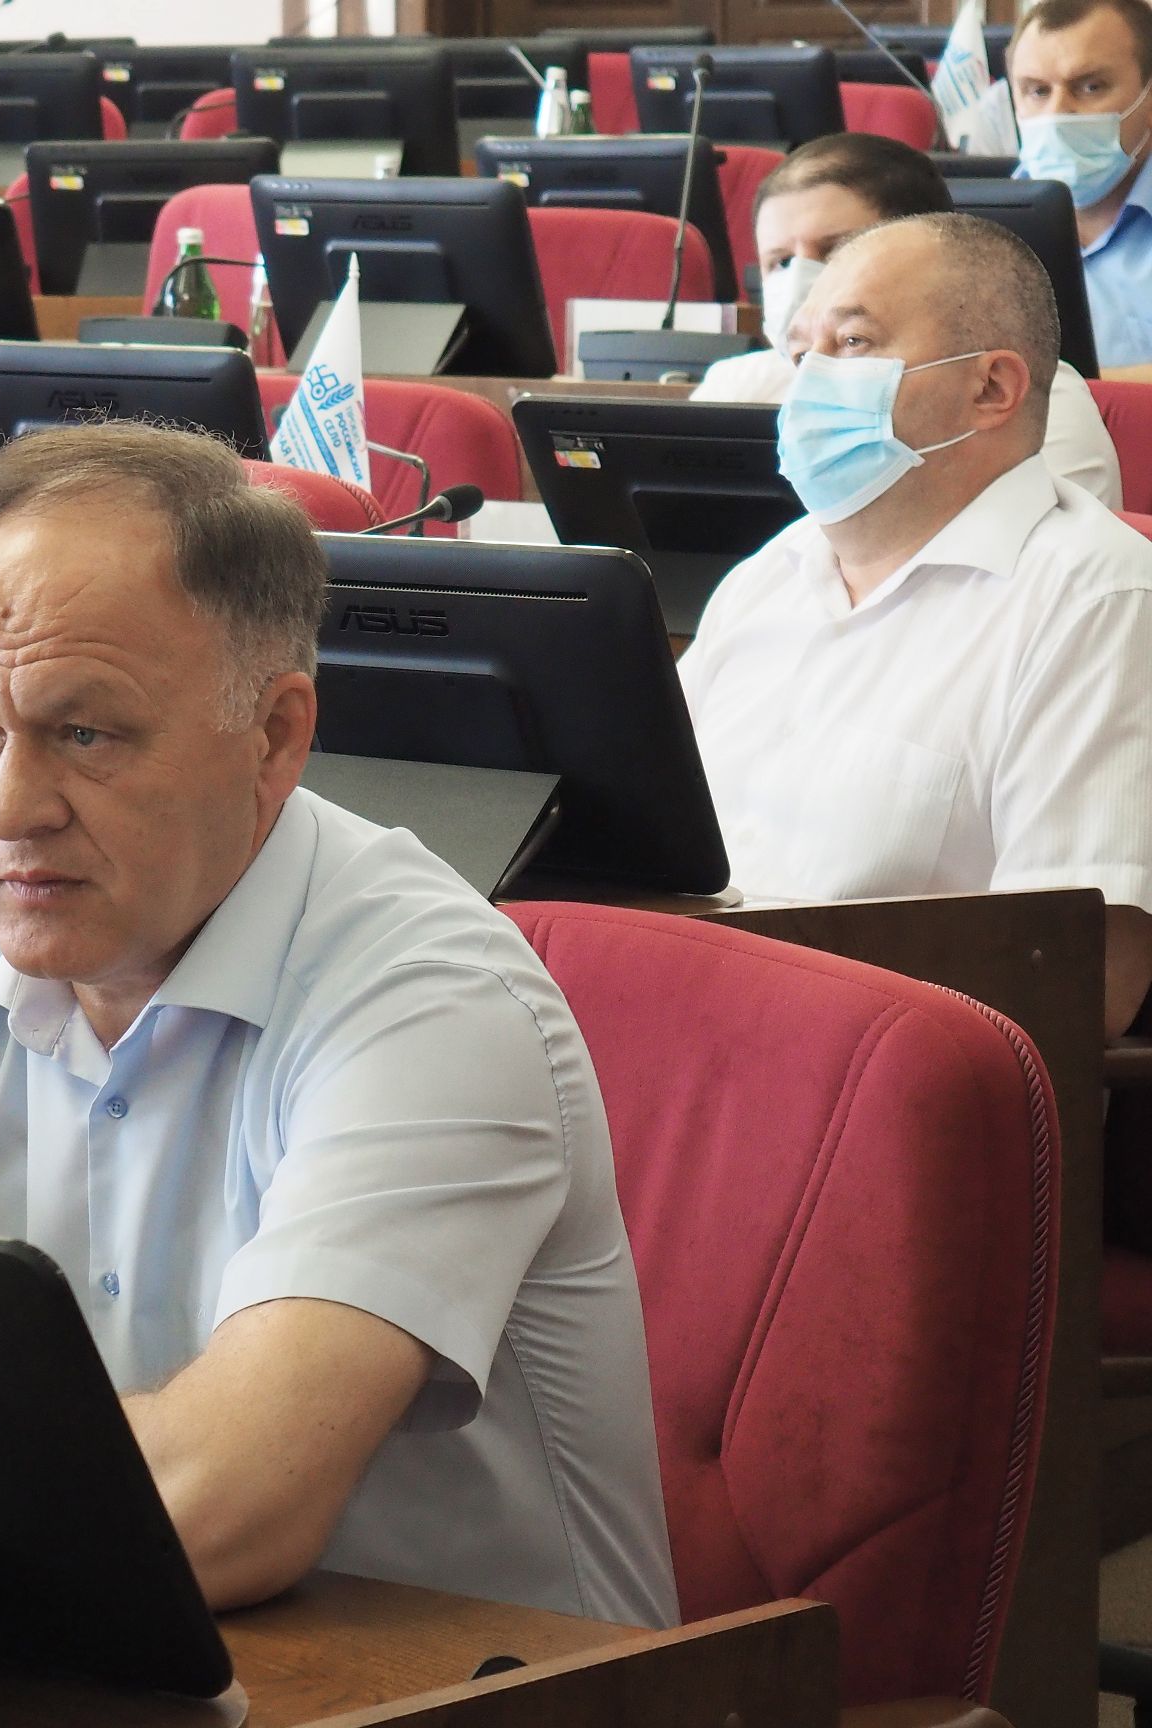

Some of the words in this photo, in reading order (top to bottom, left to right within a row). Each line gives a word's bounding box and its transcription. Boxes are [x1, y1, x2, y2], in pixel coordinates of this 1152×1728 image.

[47, 390, 119, 412] ASUS
[323, 419, 342, 448] СЕЛО
[339, 605, 449, 637] ASUS
